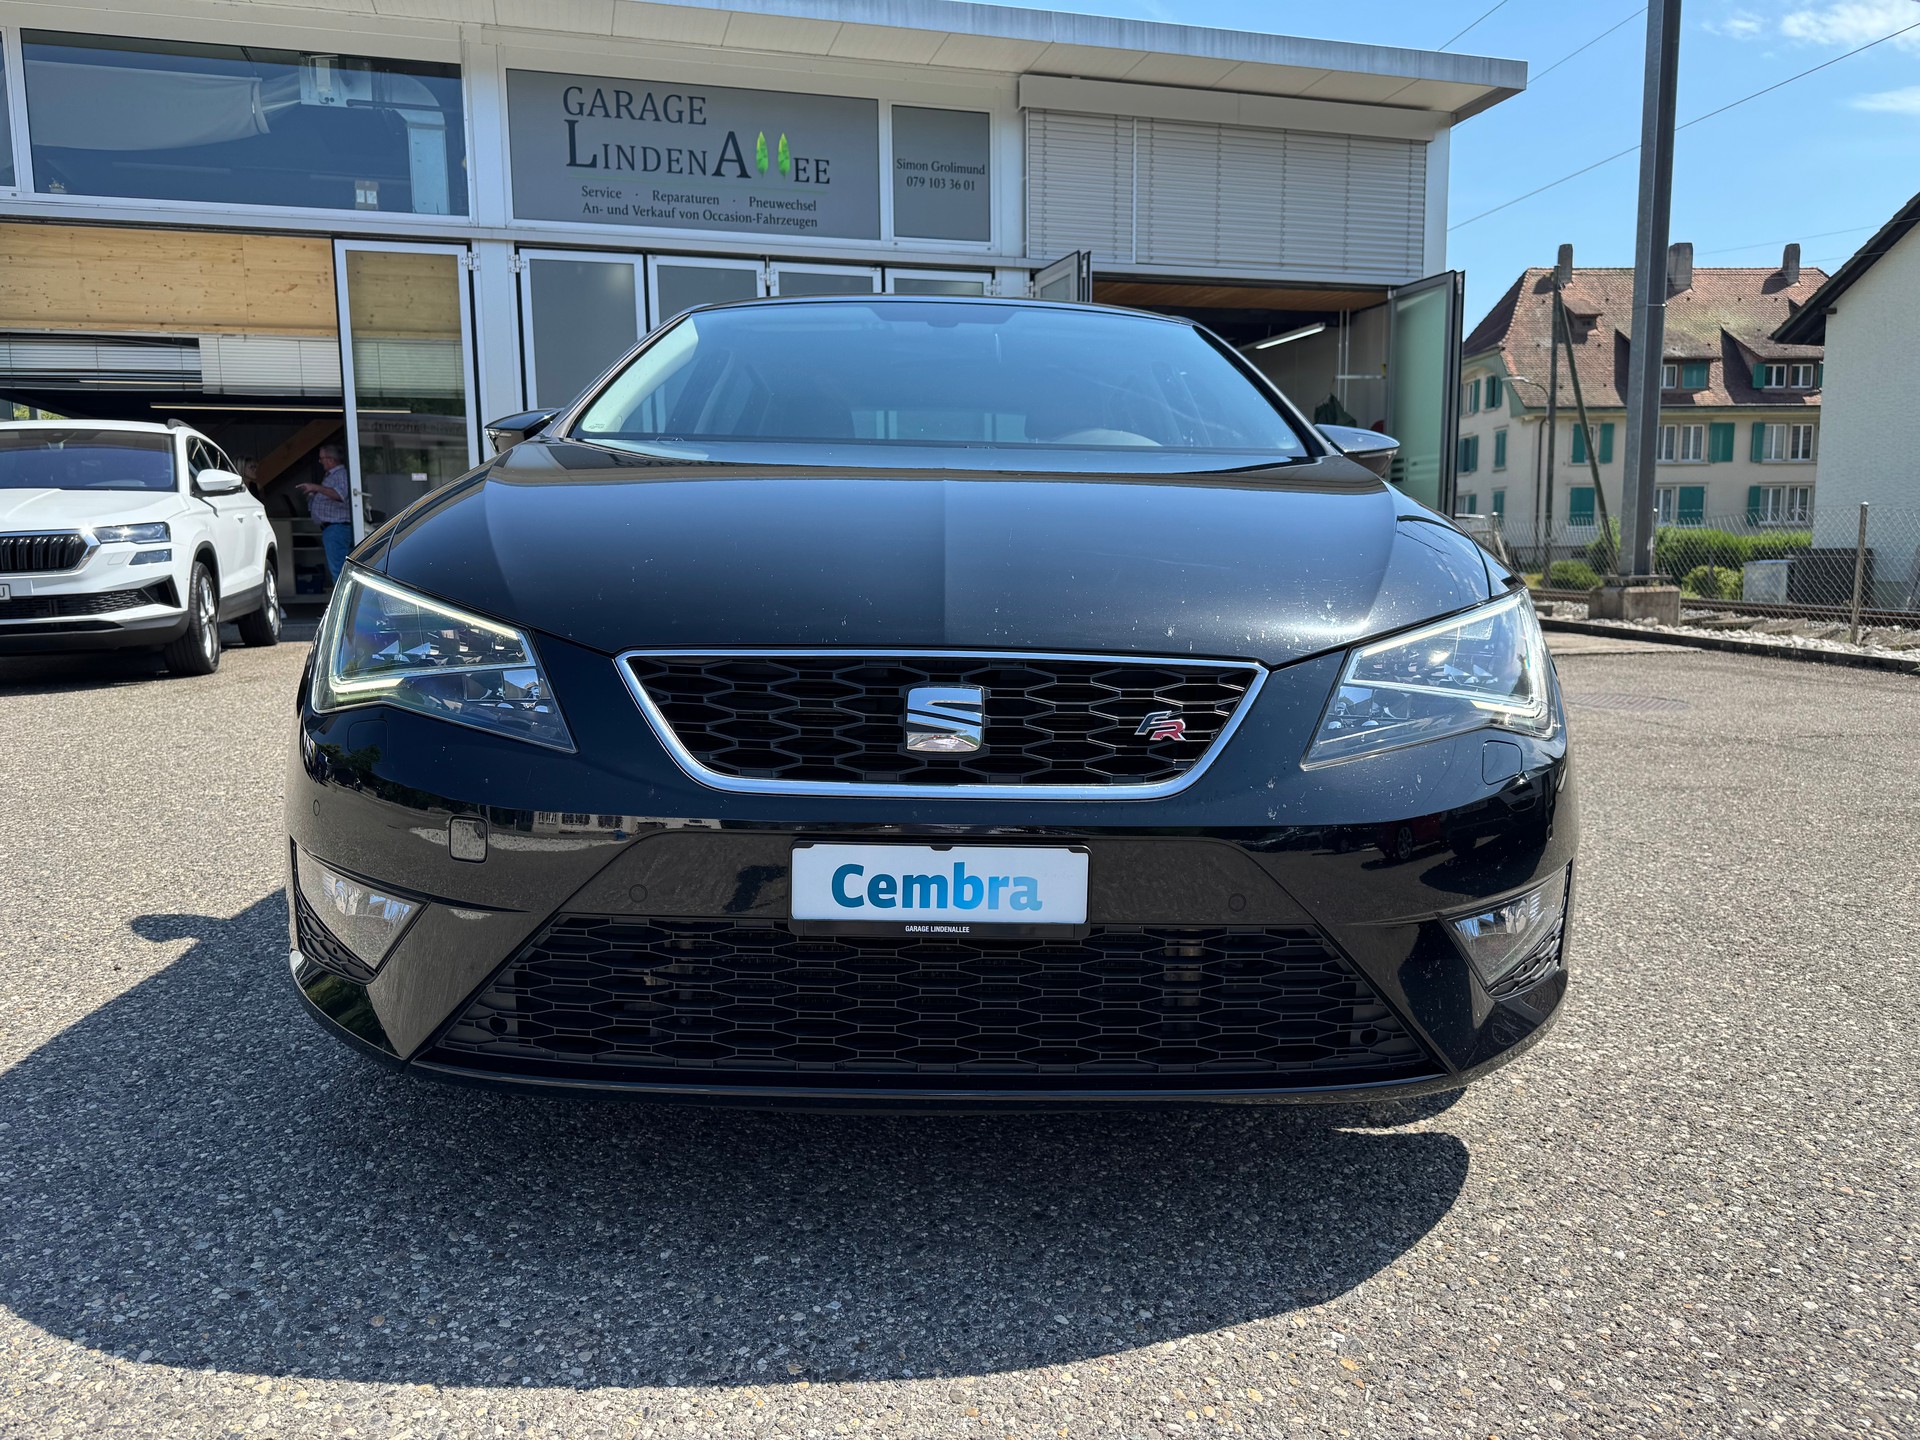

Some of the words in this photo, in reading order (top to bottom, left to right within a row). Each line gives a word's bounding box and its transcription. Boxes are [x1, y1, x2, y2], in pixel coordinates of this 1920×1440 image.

[563, 86, 707, 125] GARAGE
[896, 158, 928, 171] Simon
[931, 161, 985, 175] Grolimund
[906, 176, 925, 188] 079
[929, 178, 946, 189] 103
[949, 179, 961, 190] 36
[963, 180, 975, 191] 01
[581, 185, 622, 199] Service
[652, 190, 720, 205] Reparaturen
[749, 196, 817, 211] Pneuwechsel
[582, 202, 604, 214] An-
[607, 204, 629, 216] und
[632, 205, 677, 219] Verkauf
[679, 210, 700, 220] von
[703, 209, 818, 230] Occasion-Fahrzeugen
[831, 861, 1043, 911] Cembra
[905, 925, 930, 933] GARAGE
[930, 925, 970, 933] LINDENALLEE
